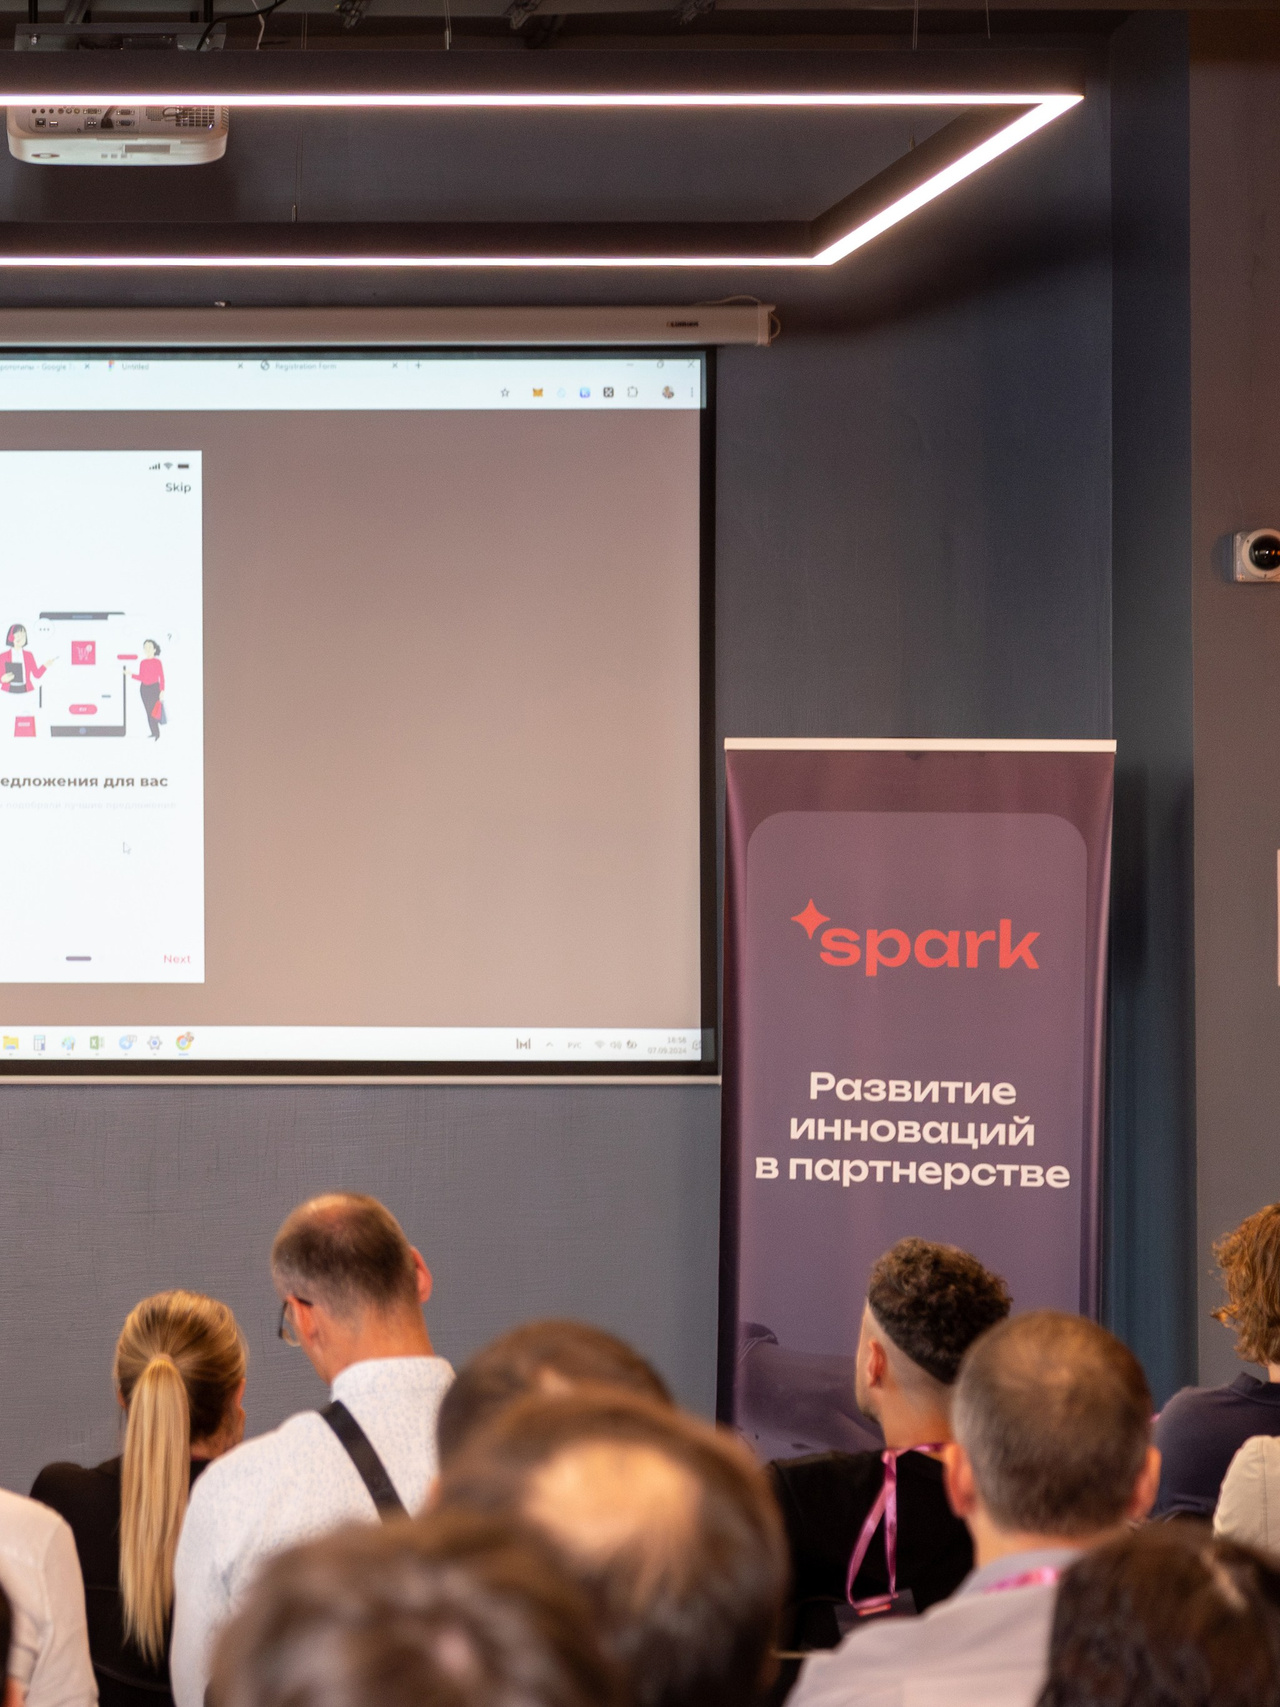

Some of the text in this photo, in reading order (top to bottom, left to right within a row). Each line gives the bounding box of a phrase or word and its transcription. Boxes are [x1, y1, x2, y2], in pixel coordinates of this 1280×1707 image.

[41, 362, 67, 372] Google
[121, 362, 150, 371] Untitled
[275, 361, 338, 372] Registration Form
[165, 481, 192, 494] Skip
[104, 777, 135, 789] для
[140, 777, 169, 787] вас
[820, 918, 1041, 977] spark
[163, 954, 192, 965] Next
[809, 1071, 1017, 1105] Развитие
[789, 1115, 1035, 1150] инноваций
[755, 1156, 1070, 1190] в партнерстве
